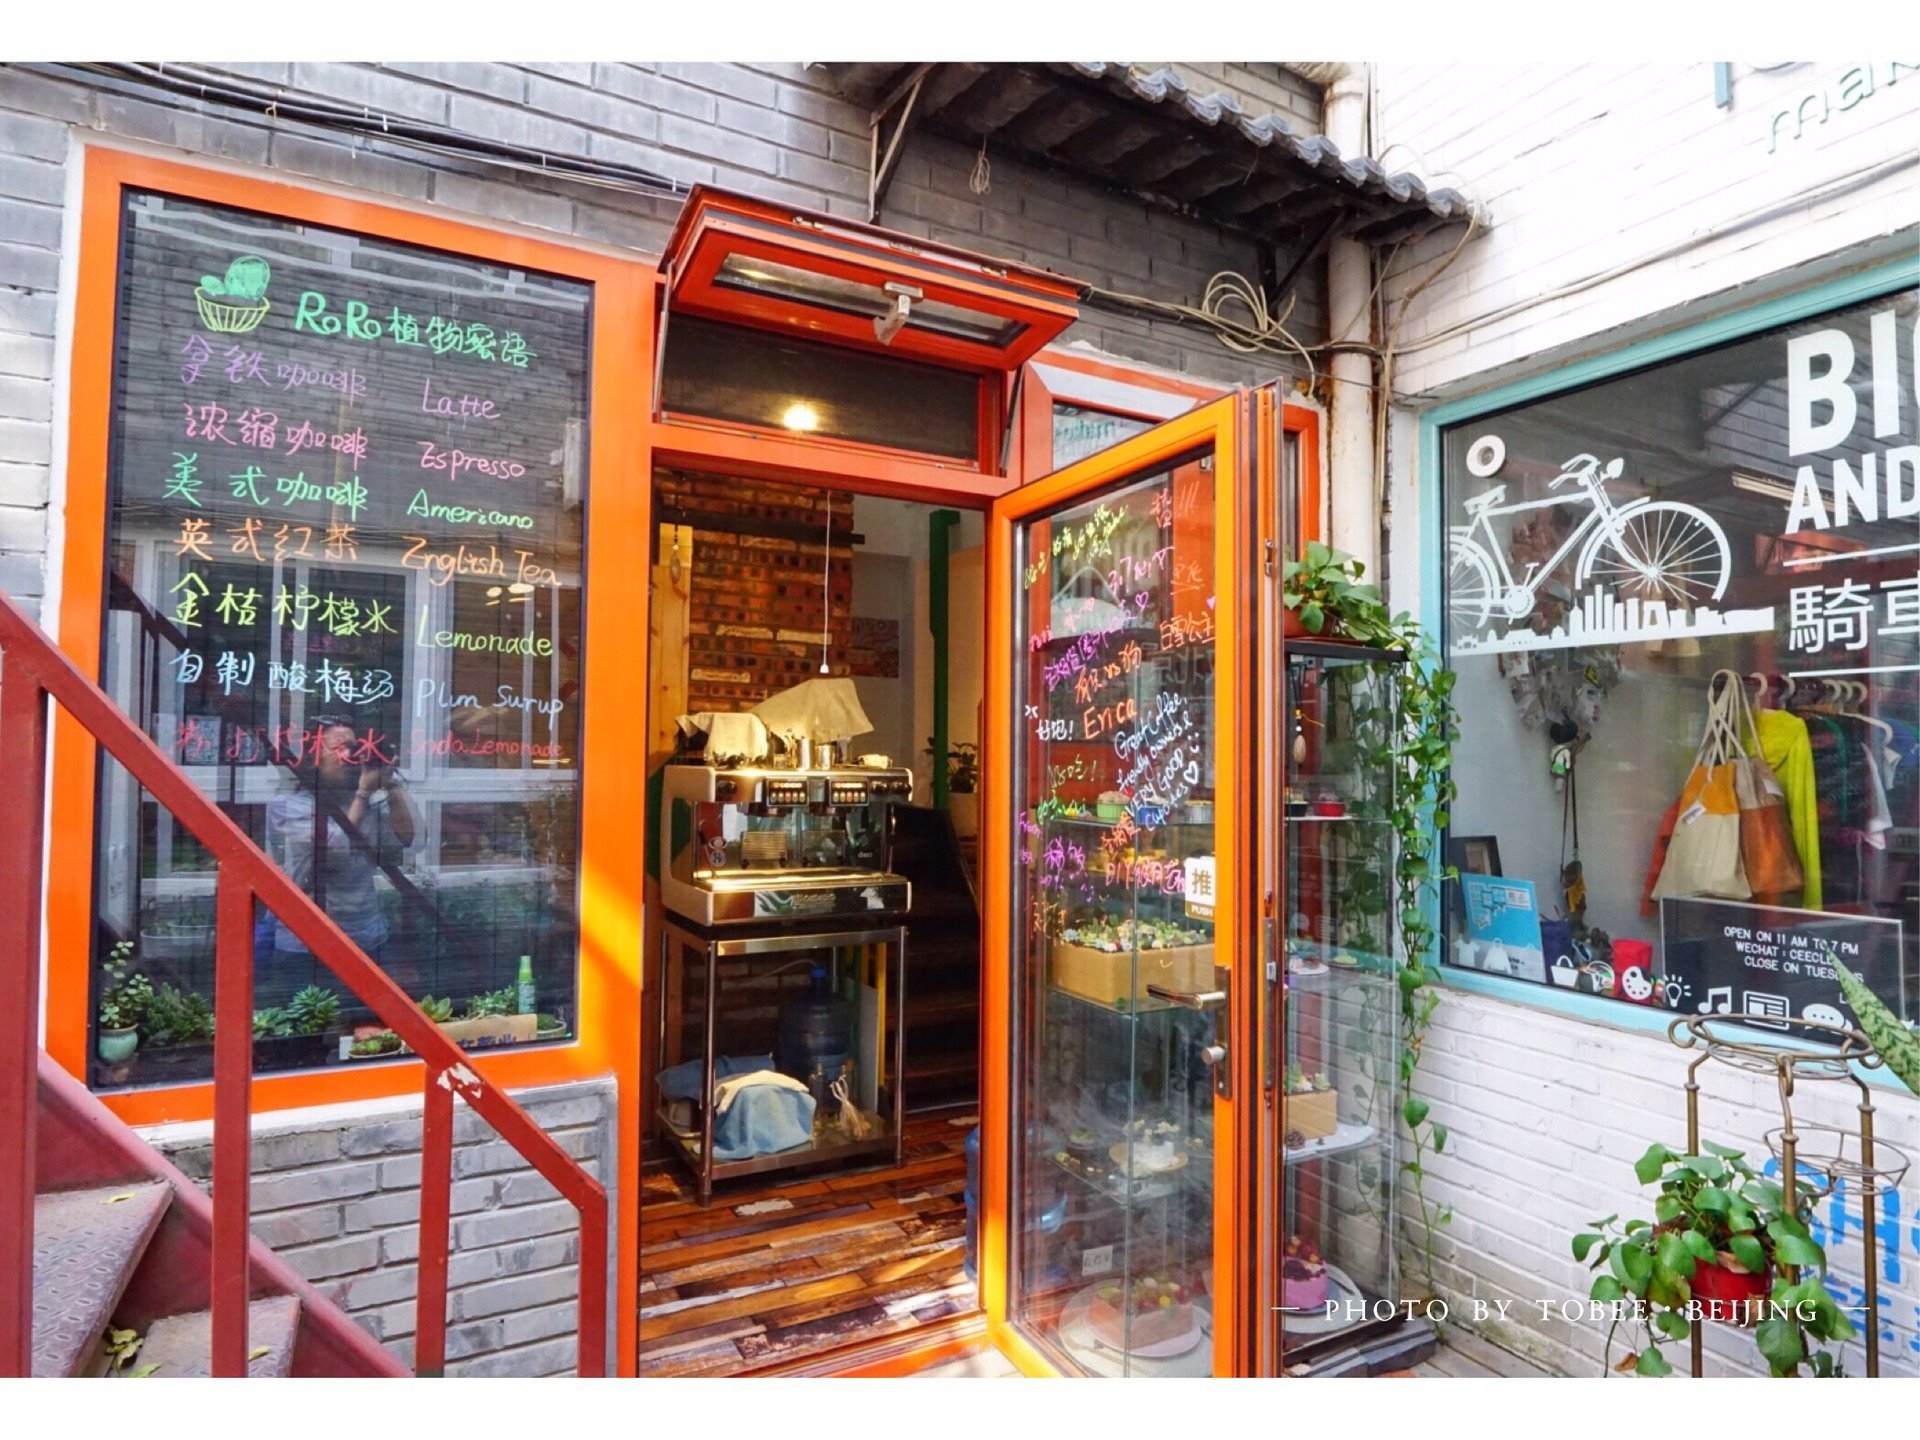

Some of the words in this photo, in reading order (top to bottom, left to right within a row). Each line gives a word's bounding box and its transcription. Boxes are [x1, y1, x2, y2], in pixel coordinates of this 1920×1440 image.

[181, 334, 368, 408] 拿铁咖啡
[422, 377, 501, 419] Latte
[1787, 309, 1920, 457] BI
[183, 401, 370, 471] 浓缩咖啡
[416, 441, 526, 481] Espresso
[162, 452, 370, 521] 美式咖啡
[407, 488, 534, 529] Americano
[1784, 445, 1920, 535] AND
[174, 517, 360, 561] 英式红茶
[401, 536, 506, 587] English
[514, 550, 562, 587] Tea
[167, 572, 399, 637] 金桔柠檬水
[416, 604, 553, 656] Lemonade
[169, 648, 394, 705] 自制酸梅汤
[1192, 867, 1212, 896] 推
[1724, 925, 1751, 940] OPEN
[1756, 929, 1772, 943] ON
[1791, 935, 1808, 948] AM
[1831, 940, 1839, 952] 7
[1841, 942, 1859, 956] PM
[1735, 940, 1780, 957] WECHAT
[1744, 956, 1779, 972] CLOSE
[1783, 962, 1800, 975] ON
